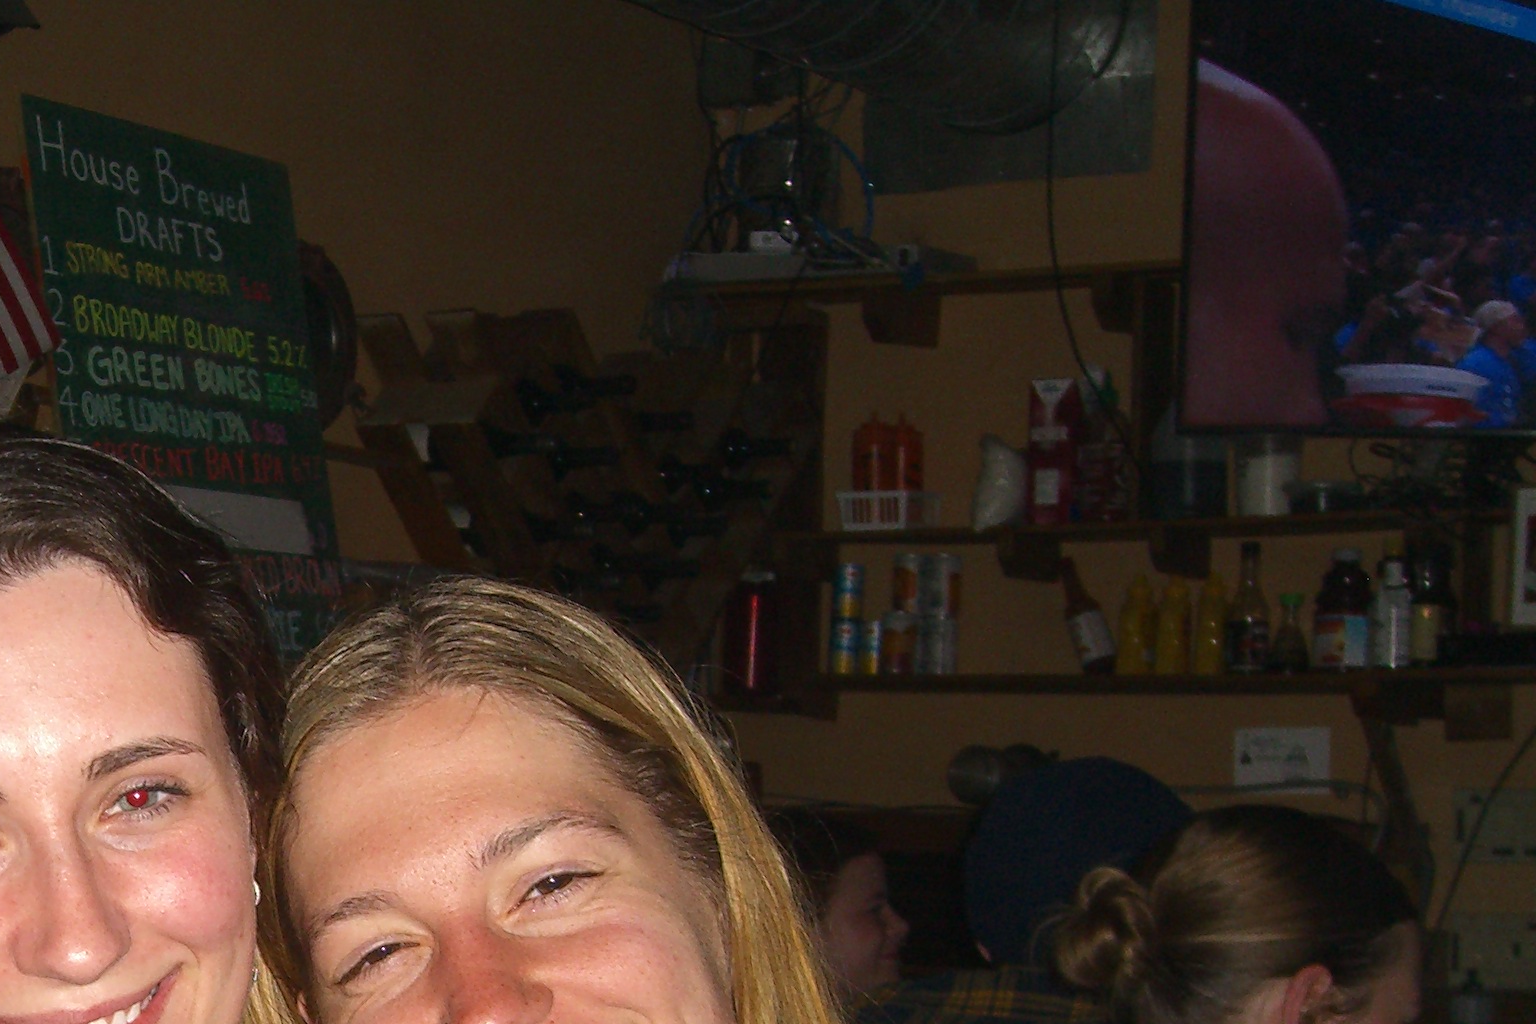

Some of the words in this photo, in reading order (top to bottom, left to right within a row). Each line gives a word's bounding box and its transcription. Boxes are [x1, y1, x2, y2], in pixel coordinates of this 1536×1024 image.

[36, 114, 140, 196] House
[154, 147, 252, 226] Brewed
[116, 205, 225, 263] DRAFTS
[65, 240, 129, 281] STRONG
[135, 260, 171, 289] ARM
[175, 264, 232, 297] AMBER
[72, 294, 179, 346] BROADWAY
[183, 316, 260, 364] BLONDE
[86, 345, 185, 391] GREEN
[194, 357, 262, 402] BONES
[81, 391, 126, 430] ONE
[128, 396, 180, 438] LONG
[180, 407, 213, 442] DAY
[213, 411, 253, 445] IPA
[92, 441, 198, 482] ESCENT
[204, 445, 247, 486] BAY
[252, 454, 286, 486] IPA
